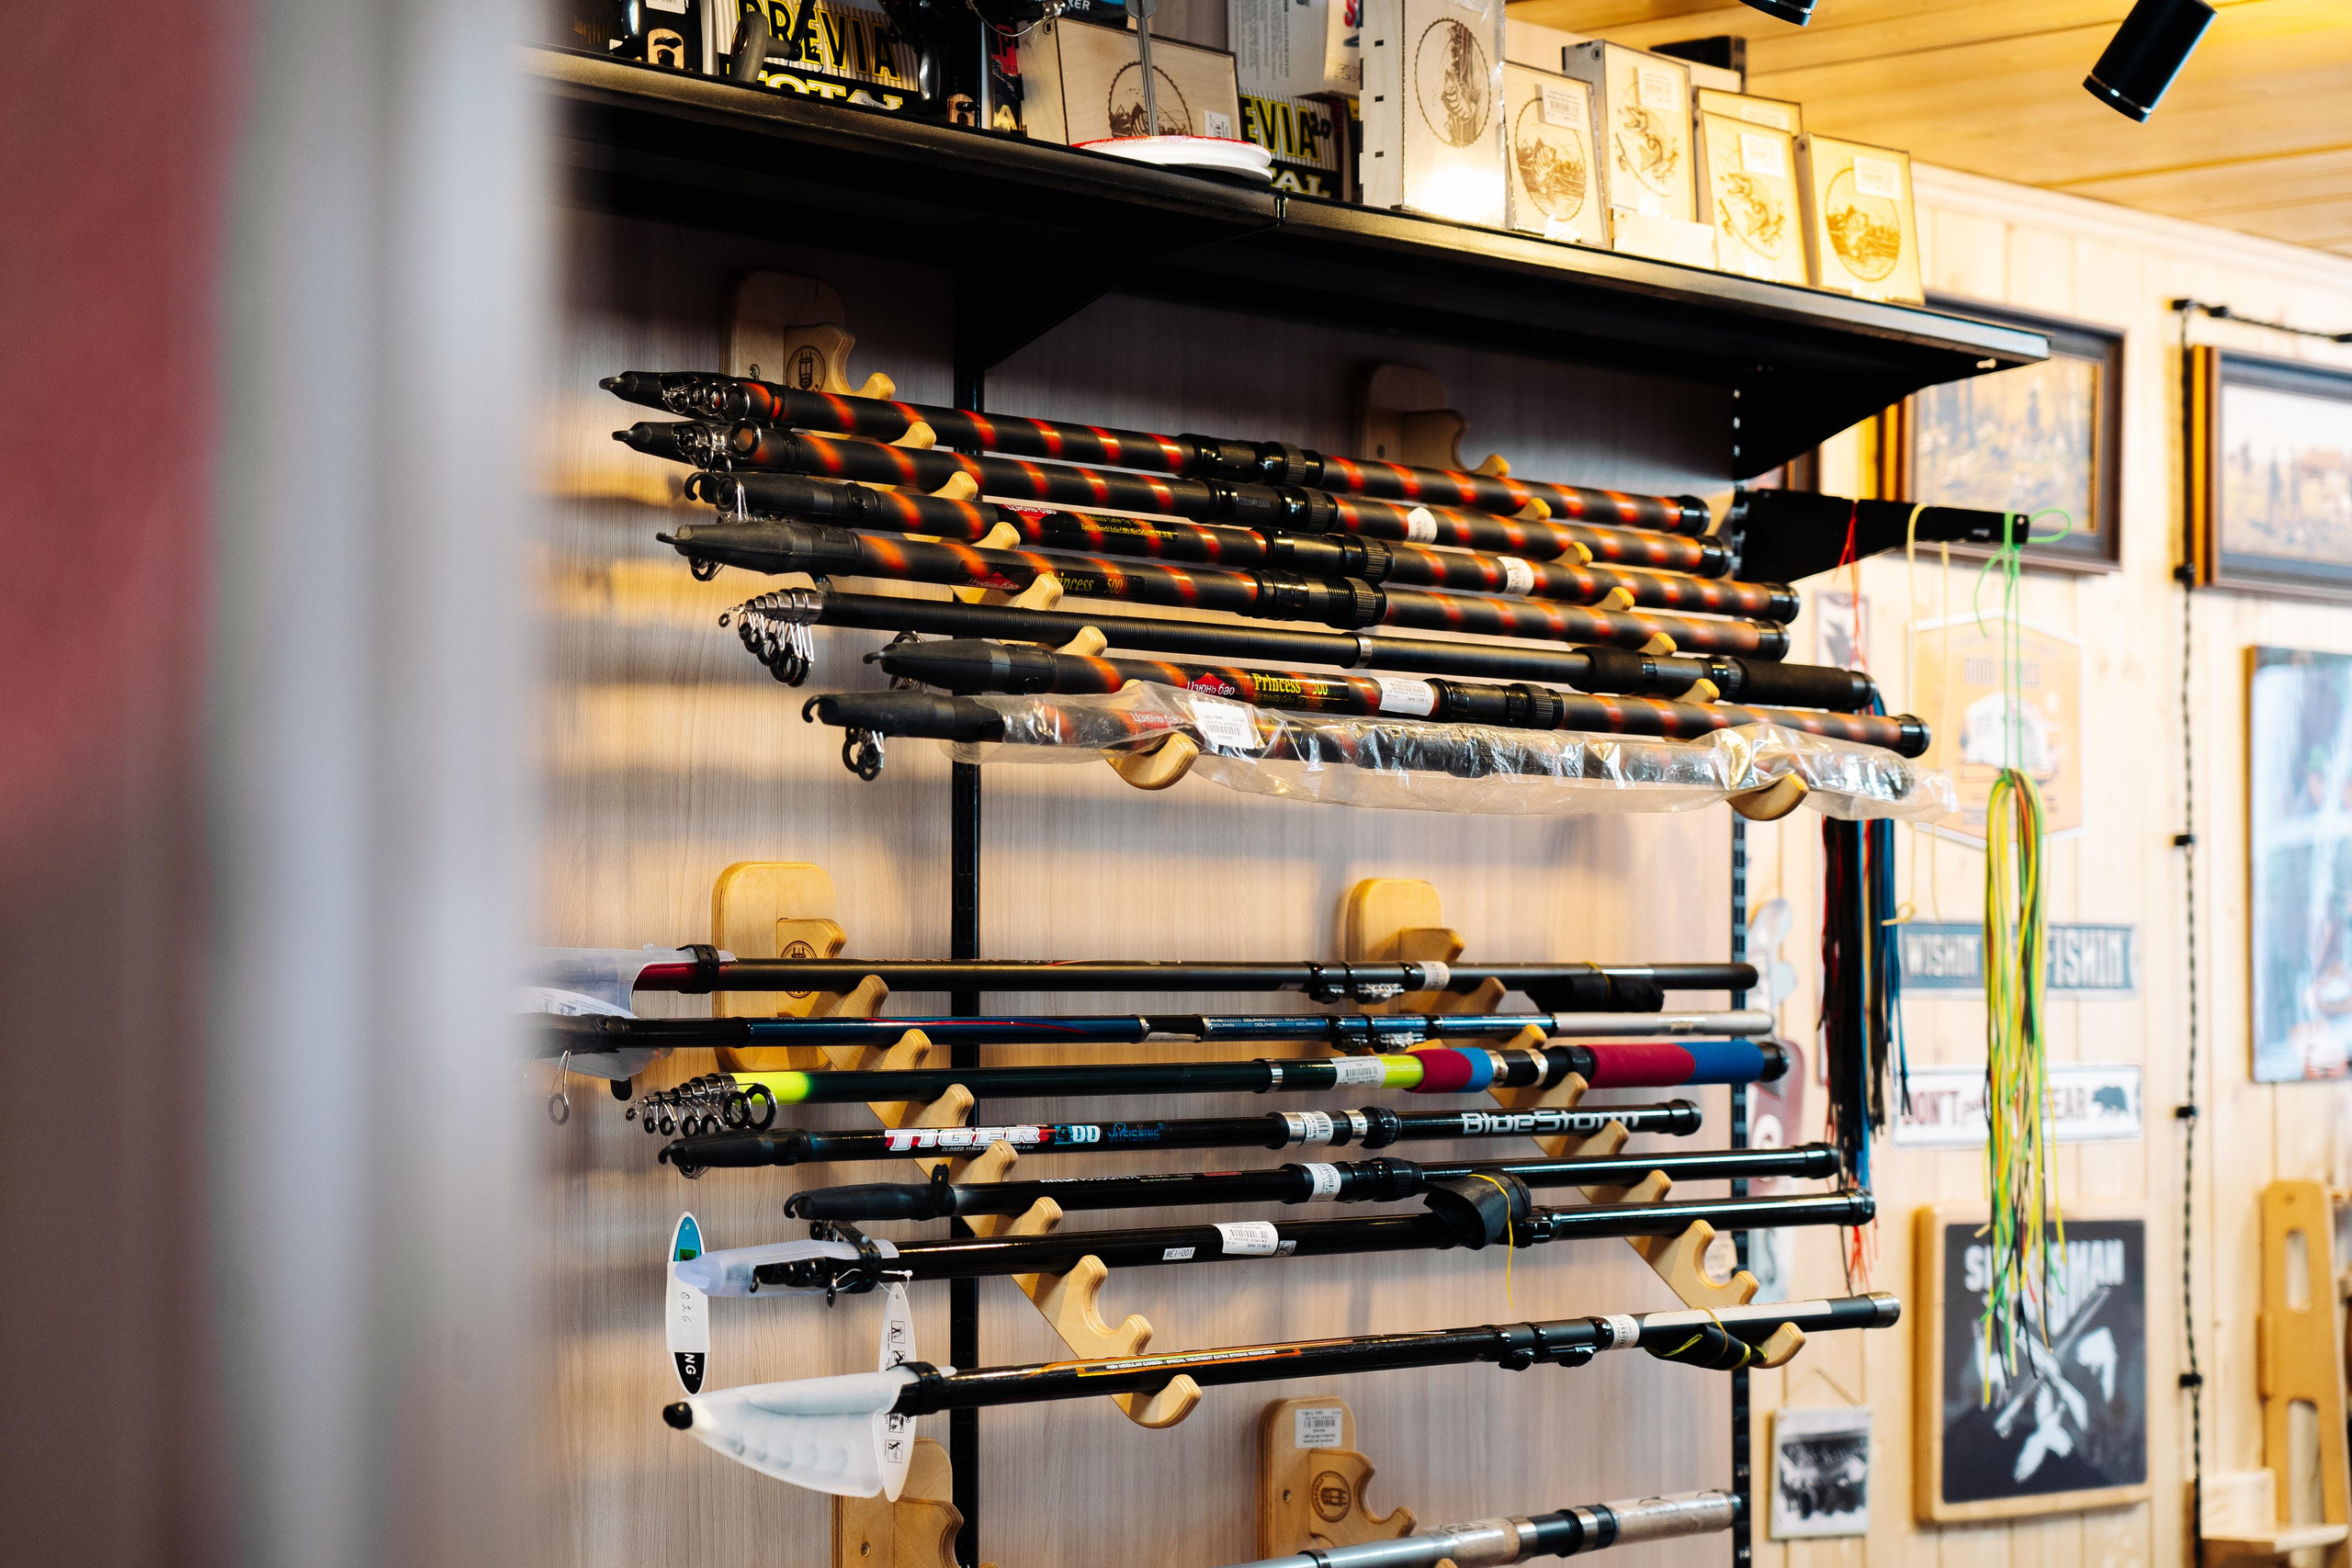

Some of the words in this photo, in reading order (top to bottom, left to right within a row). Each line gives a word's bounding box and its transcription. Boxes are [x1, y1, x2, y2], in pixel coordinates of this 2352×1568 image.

[1046, 570, 1094, 592] incess
[1104, 578, 1123, 595] 500
[1186, 680, 1216, 694] Цзюнь
[1217, 682, 1236, 696] бао
[1251, 672, 1301, 694] Princess
[1461, 1109, 1640, 1134] BlueStorm
[885, 1126, 1041, 1152] TIGER
[1186, 1355, 1213, 1363] TREATMENT
[1248, 1349, 1276, 1358] RESISTANCE
